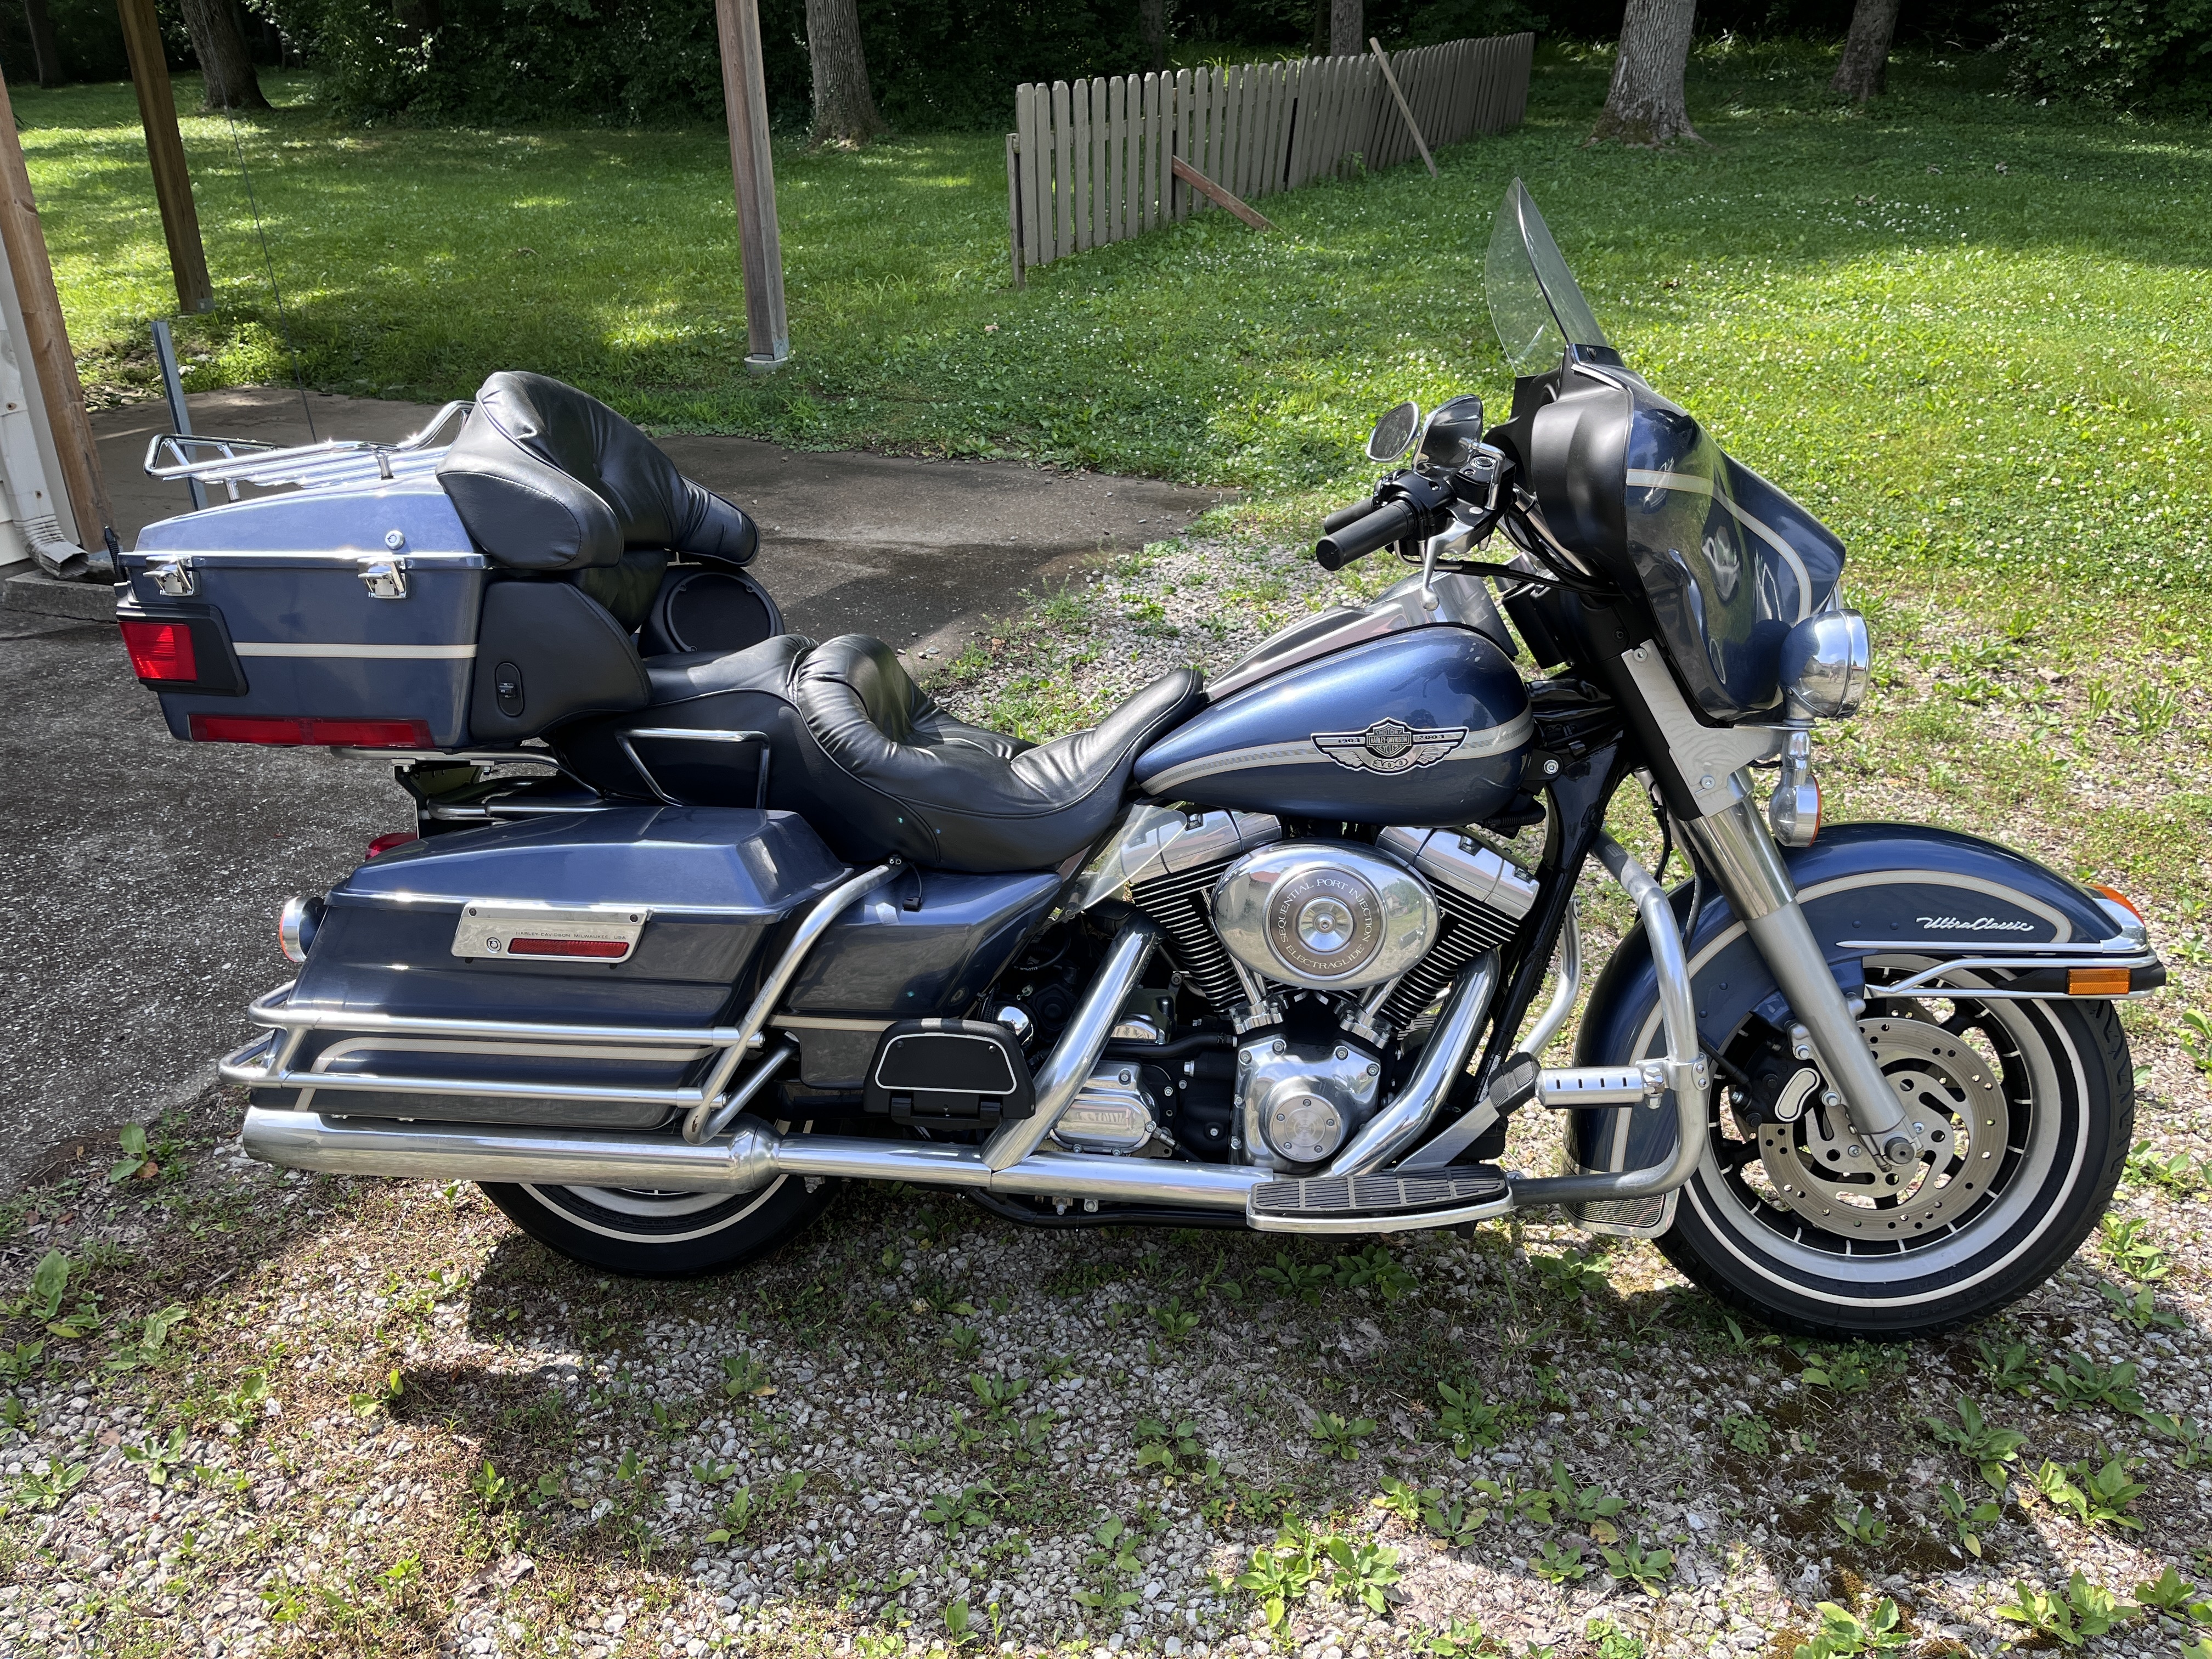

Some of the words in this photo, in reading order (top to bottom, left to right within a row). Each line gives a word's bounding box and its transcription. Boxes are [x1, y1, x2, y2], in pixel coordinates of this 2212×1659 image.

[1379, 744, 1399, 753] CYCLES
[1373, 758, 1408, 769] 100
[1278, 883, 1314, 943] SEQUENTIAL
[1317, 879, 1348, 890] PORT
[1349, 888, 1372, 943] INJECTION
